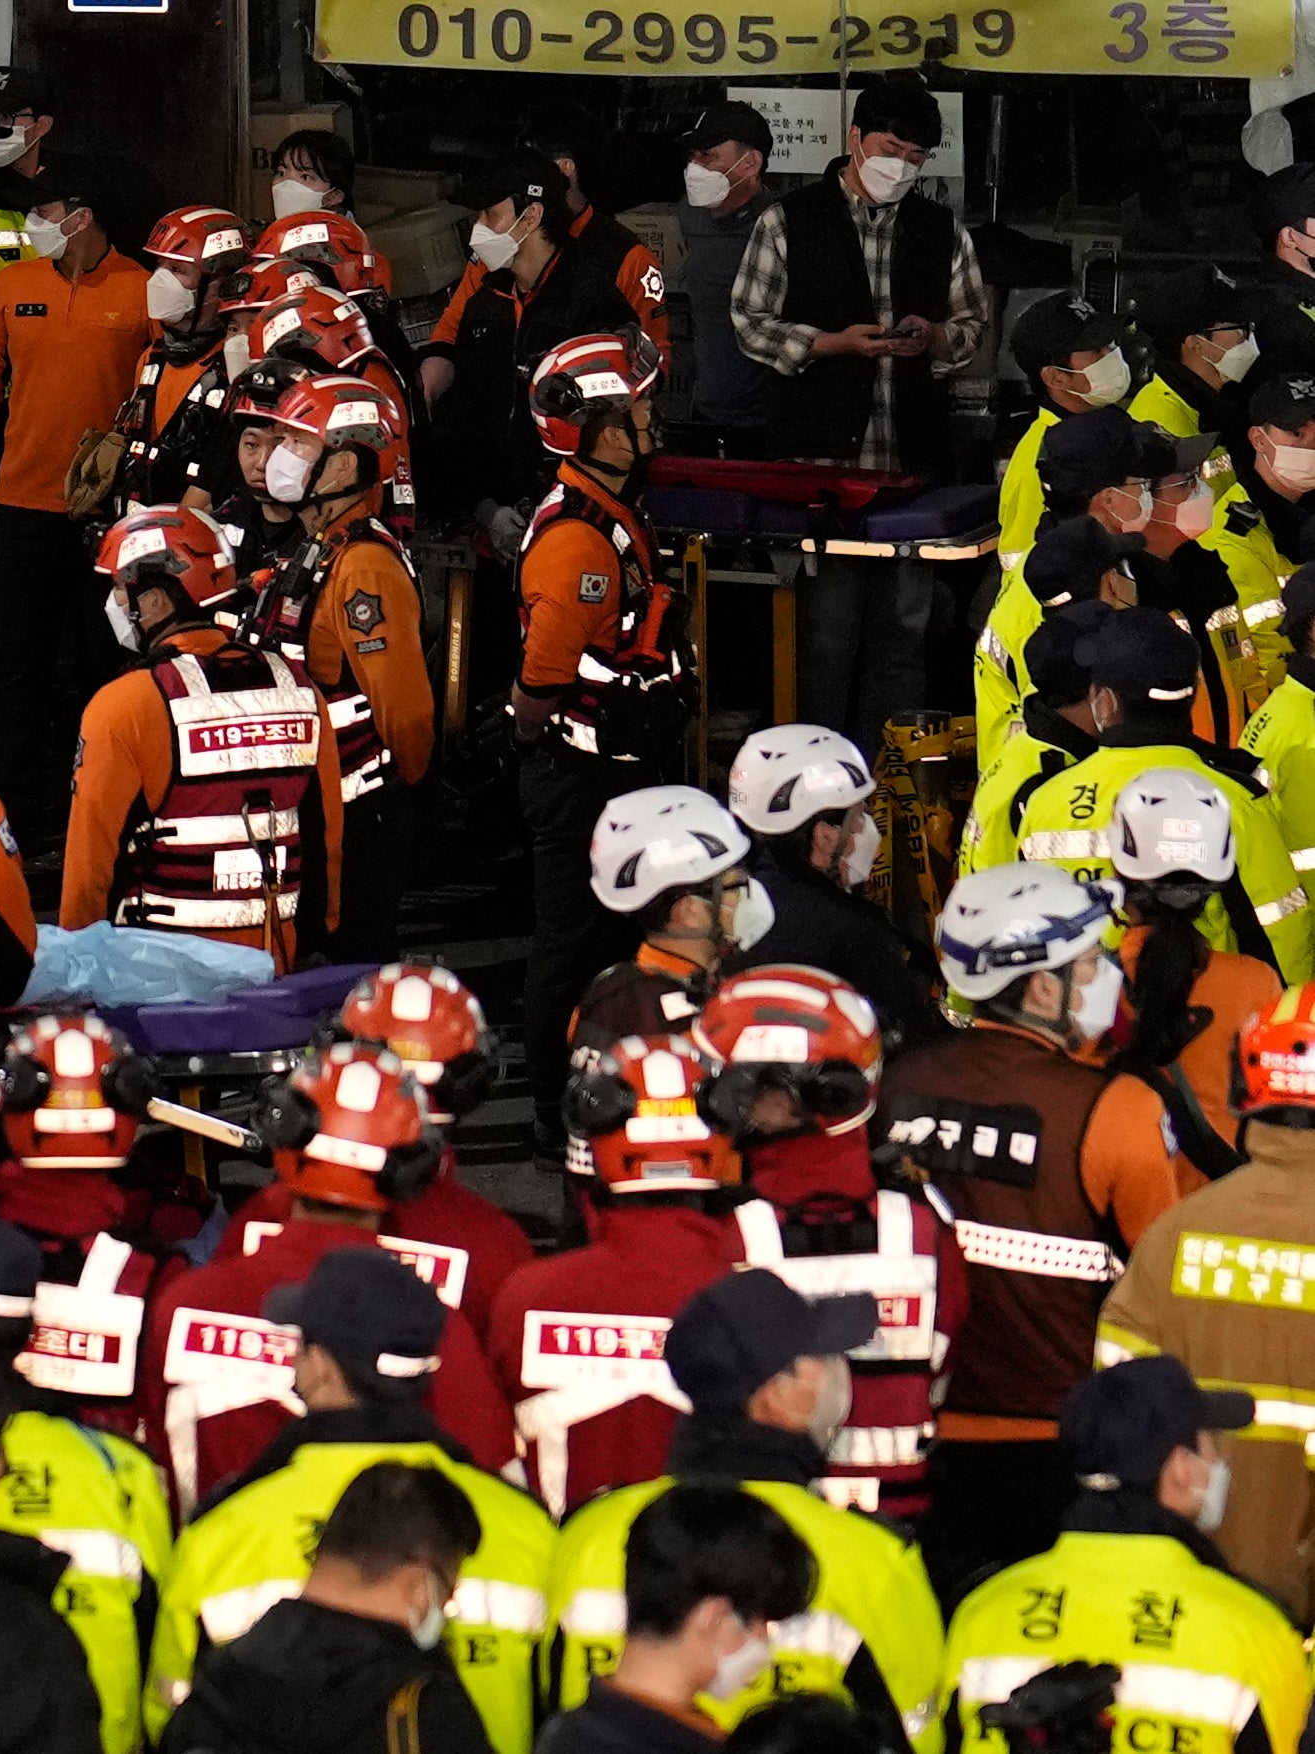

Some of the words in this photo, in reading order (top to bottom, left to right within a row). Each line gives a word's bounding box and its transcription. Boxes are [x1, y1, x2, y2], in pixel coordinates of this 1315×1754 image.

[397, 3, 1014, 62] 010-2995-2319
[1103, 0, 1236, 63] 3층
[200, 722, 306, 748] 119구조대
[200, 1325, 298, 1365] 119구
[552, 1325, 666, 1359] 119구
